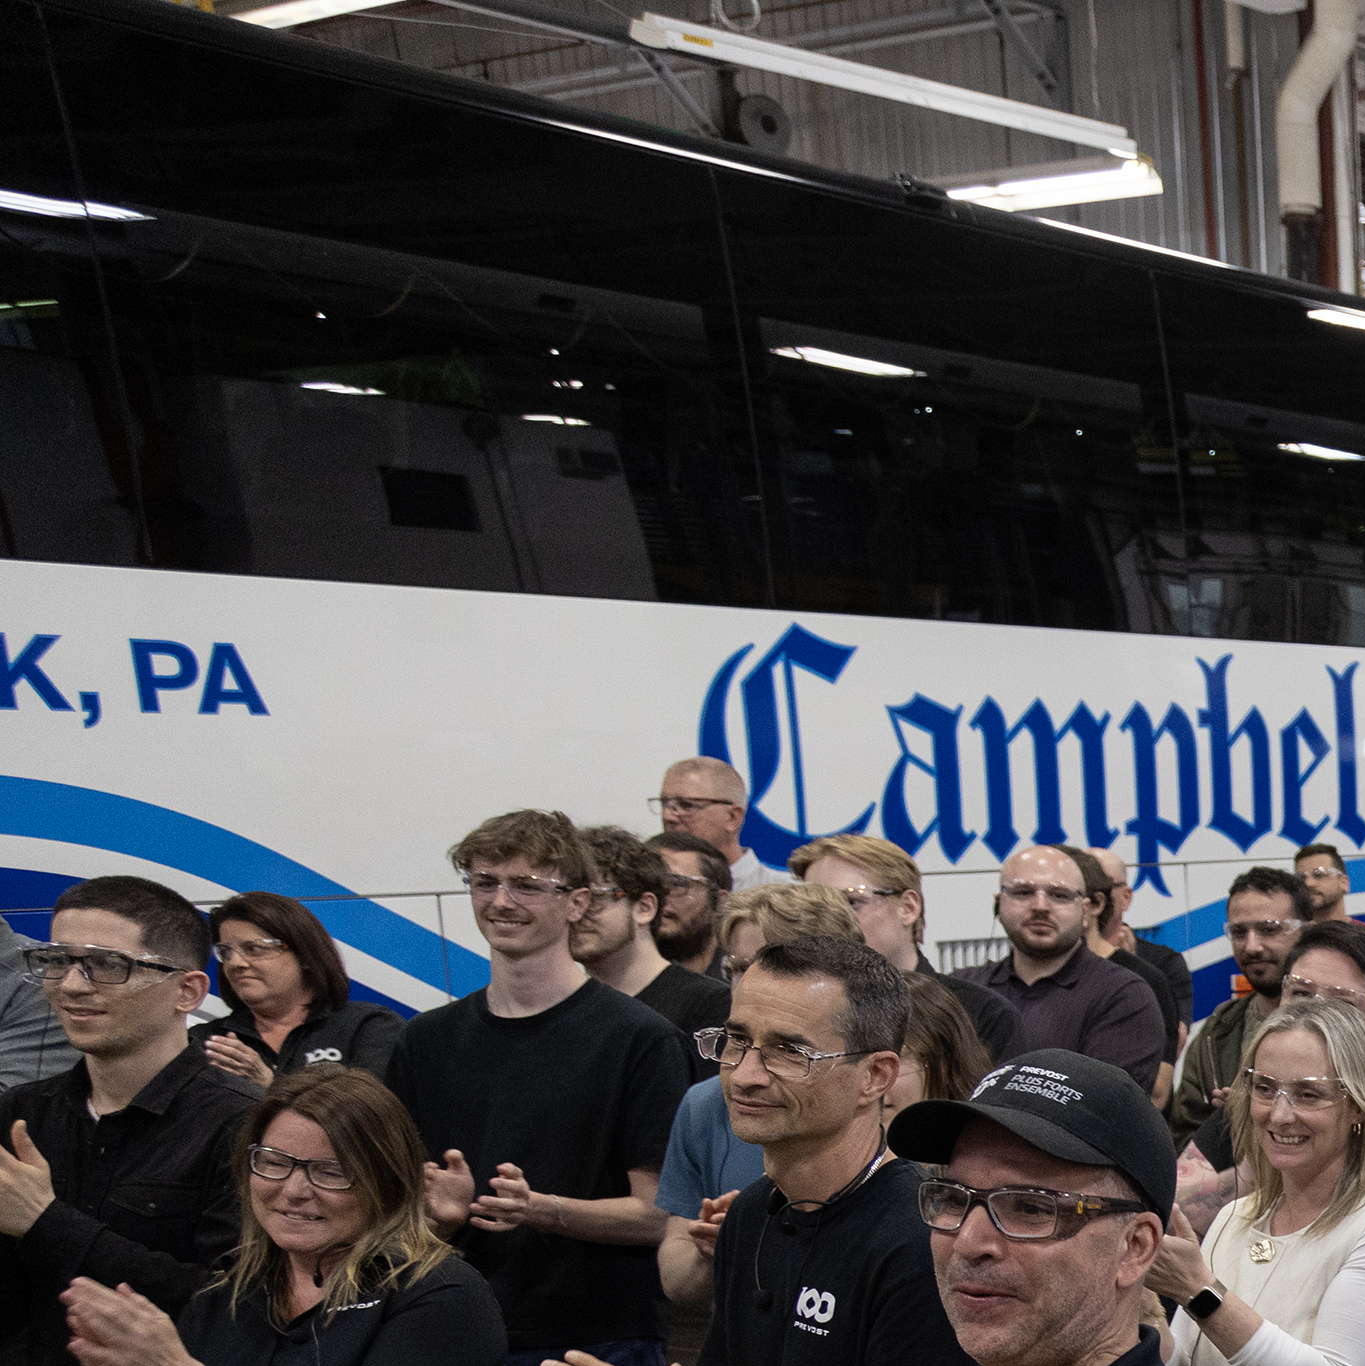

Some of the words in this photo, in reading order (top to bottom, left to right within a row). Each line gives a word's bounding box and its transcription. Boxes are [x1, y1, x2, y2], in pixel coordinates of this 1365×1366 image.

[0, 632, 102, 729] K,
[129, 638, 271, 716] PA
[1019, 1065, 1070, 1082] PREVOST
[1003, 1082, 1070, 1105] ENSEMBLE
[1011, 1074, 1044, 1086] PLUS
[1042, 1080, 1084, 1101] FORTS
[796, 1286, 836, 1323] 100
[793, 1321, 830, 1336] PREVOST
